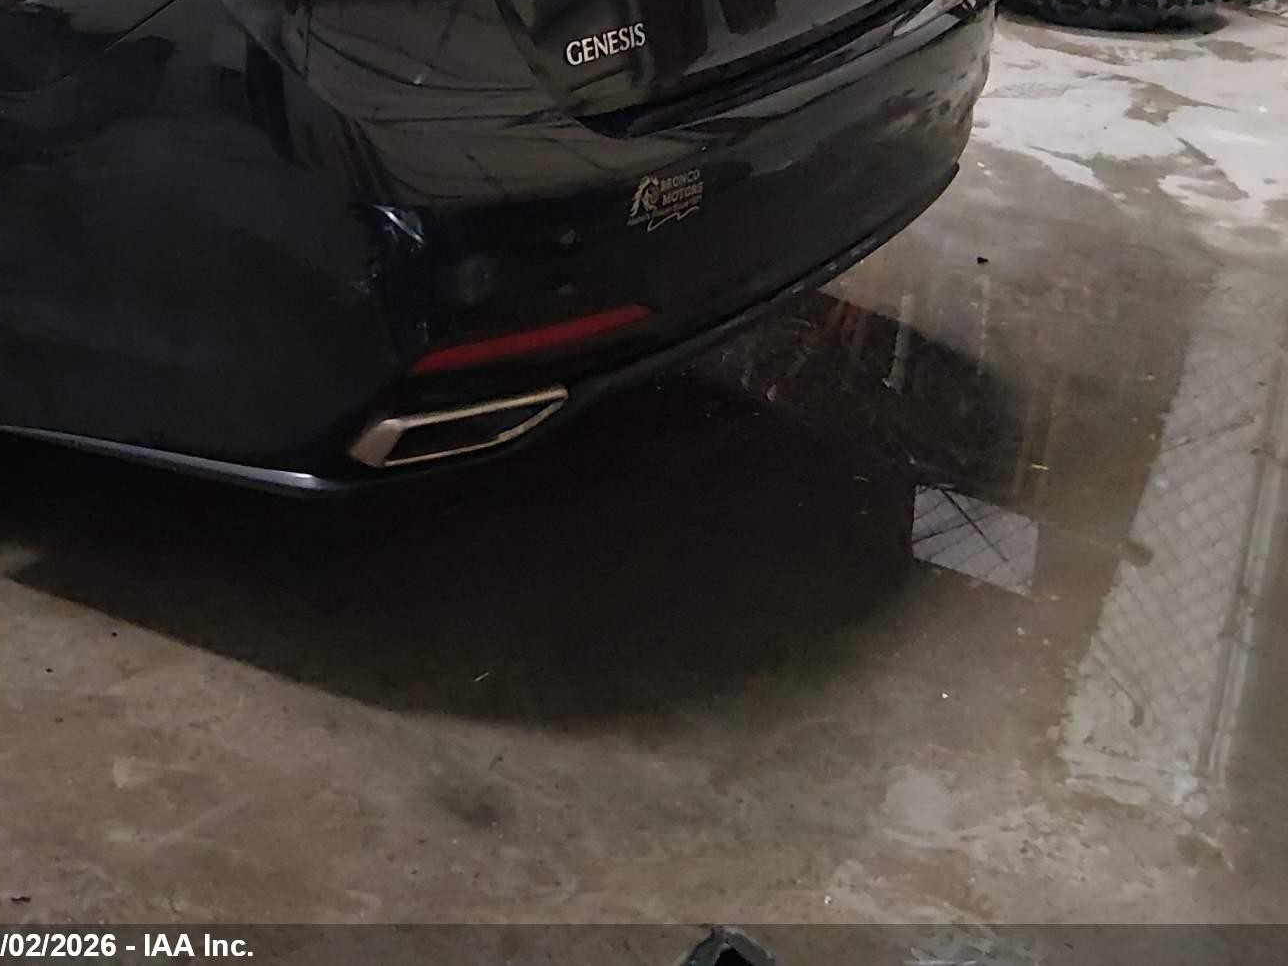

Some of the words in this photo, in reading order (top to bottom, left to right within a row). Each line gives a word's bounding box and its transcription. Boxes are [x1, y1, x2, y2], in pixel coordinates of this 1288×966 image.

[566, 22, 646, 66] GENESIS
[660, 168, 700, 192] BRONCO
[662, 181, 704, 206] MOTORS
